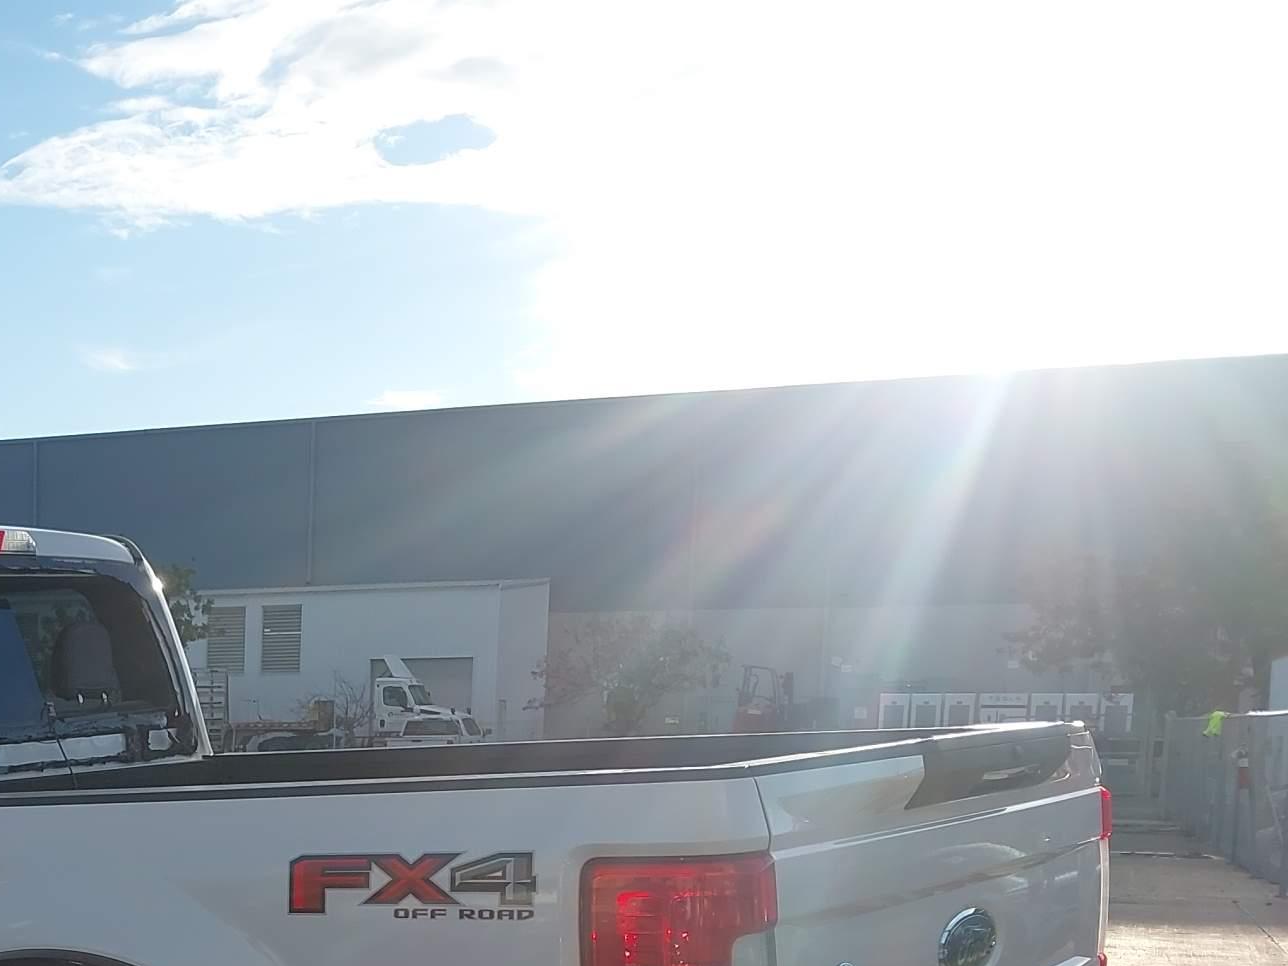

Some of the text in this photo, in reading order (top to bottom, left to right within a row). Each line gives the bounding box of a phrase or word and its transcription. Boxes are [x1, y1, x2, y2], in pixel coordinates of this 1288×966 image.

[289, 852, 536, 914] FX4
[394, 908, 534, 920] OFF ROAD
